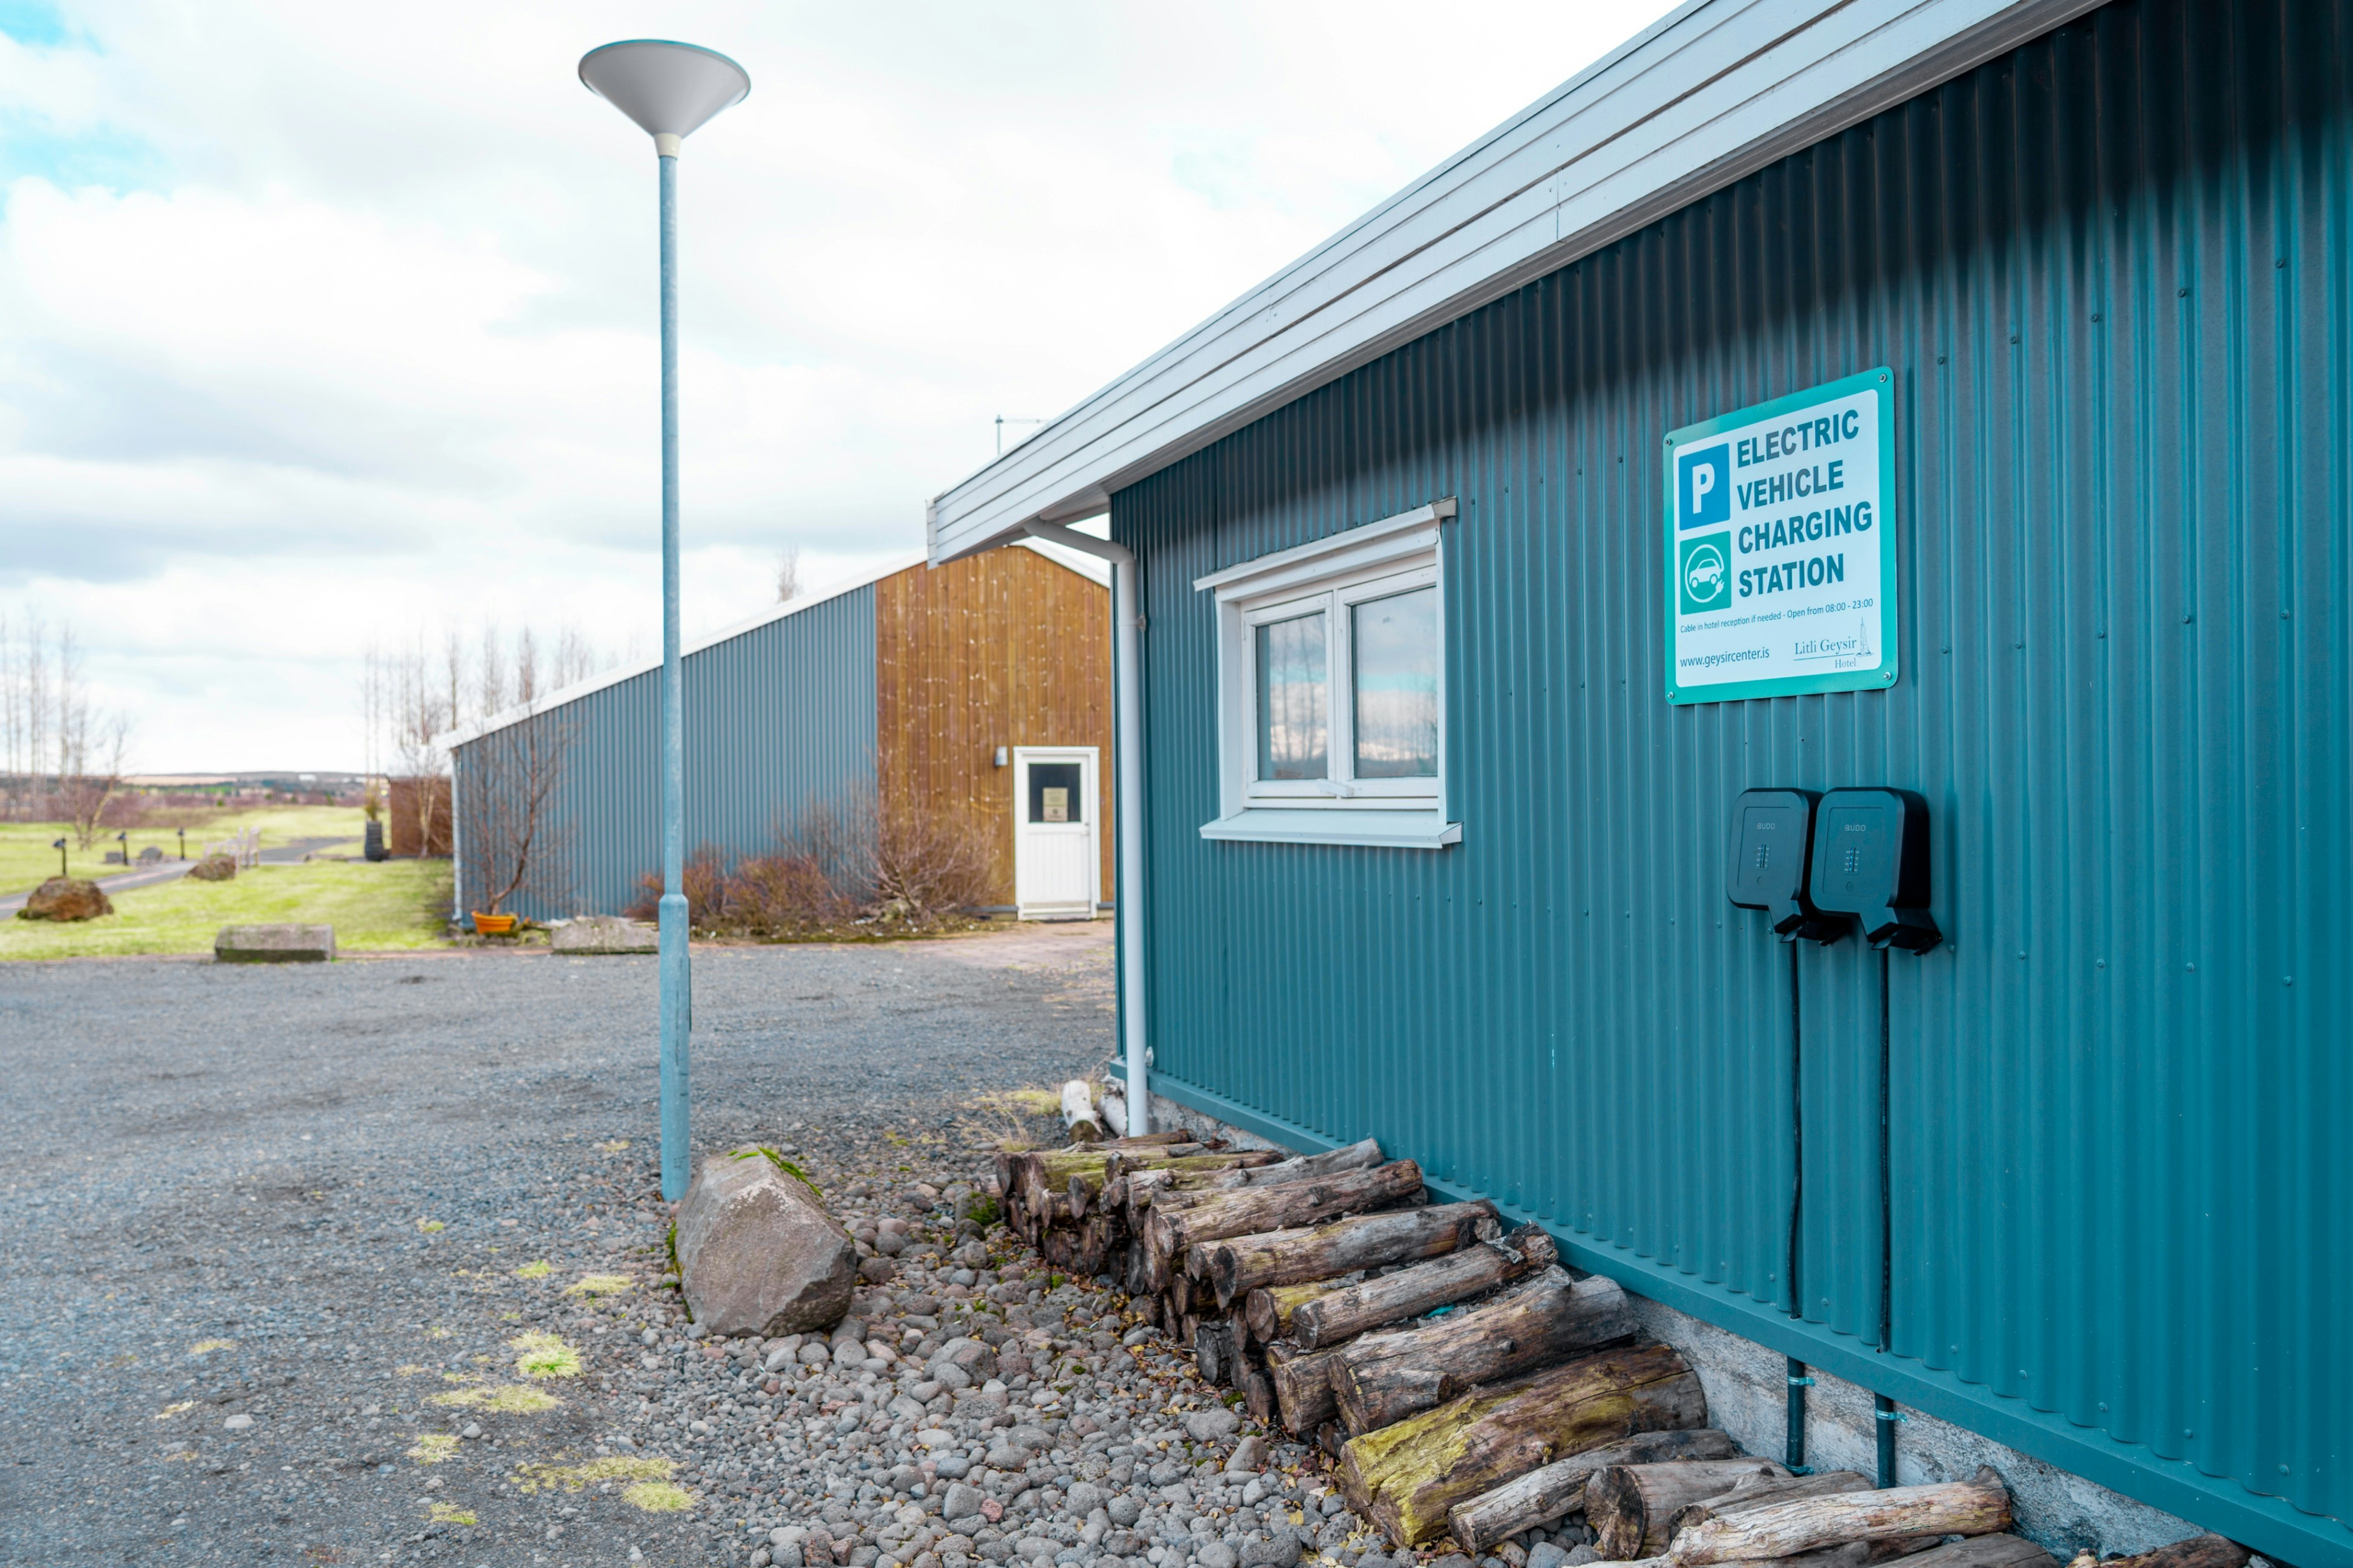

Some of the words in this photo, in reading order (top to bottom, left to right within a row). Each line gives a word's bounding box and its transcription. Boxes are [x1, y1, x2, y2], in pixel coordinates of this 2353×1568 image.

[1737, 409, 1860, 469] ELECTRIC
[1691, 463, 1716, 515] P
[1737, 459, 1844, 510] VEHICLE
[1738, 501, 1872, 554] CHARGING
[1739, 553, 1844, 598] STATION
[1680, 623, 1696, 633] Cable
[1704, 620, 1720, 629] hotel
[1720, 616, 1750, 628] reception
[1751, 614, 1756, 623] if
[1757, 611, 1782, 622] needed
[1787, 610, 1805, 619] Open
[1807, 606, 1824, 615] from
[1825, 602, 1846, 613] 08:00
[1852, 598, 1873, 610] 23:00
[1680, 646, 1770, 668] www.geysircenter.is
[1795, 640, 1817, 655] Litli
[1820, 636, 1857, 655] Geysir
[1834, 657, 1857, 668] Hotel
